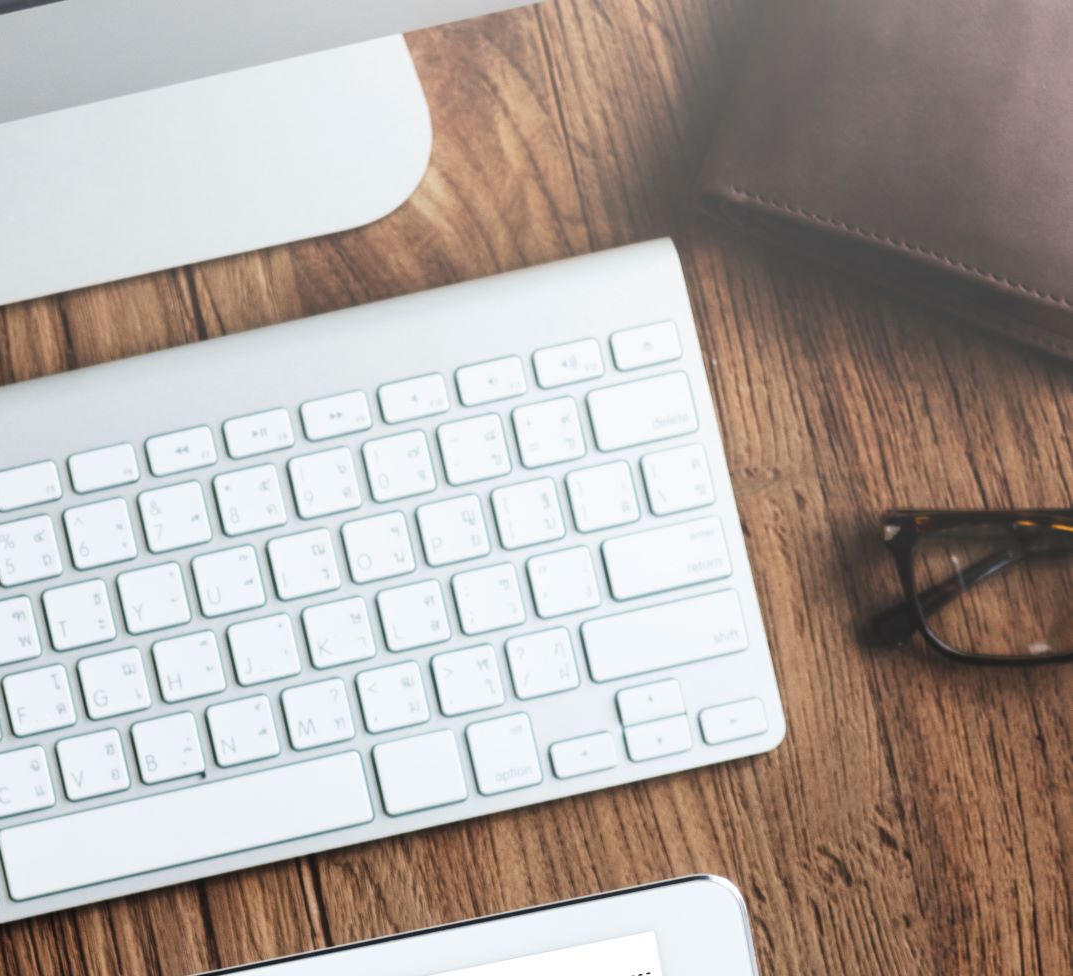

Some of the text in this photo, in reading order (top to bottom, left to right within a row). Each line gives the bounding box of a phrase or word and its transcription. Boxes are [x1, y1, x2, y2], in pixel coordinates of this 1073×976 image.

[228, 507, 240, 524] 8
[154, 523, 165, 541] 7
[78, 540, 90, 558] 6
[5, 556, 17, 574] 5
[686, 556, 724, 575] return
[206, 585, 222, 604] U
[131, 603, 144, 622] Y
[57, 620, 68, 638] T
[711, 628, 740, 646] shift
[317, 638, 334, 656] K
[165, 671, 183, 690] H
[93, 689, 109, 707] G
[16, 705, 28, 724] F
[297, 717, 319, 738] M
[220, 736, 238, 755] N
[144, 753, 159, 772] B
[69, 768, 84, 788] V
[495, 766, 534, 785] option
